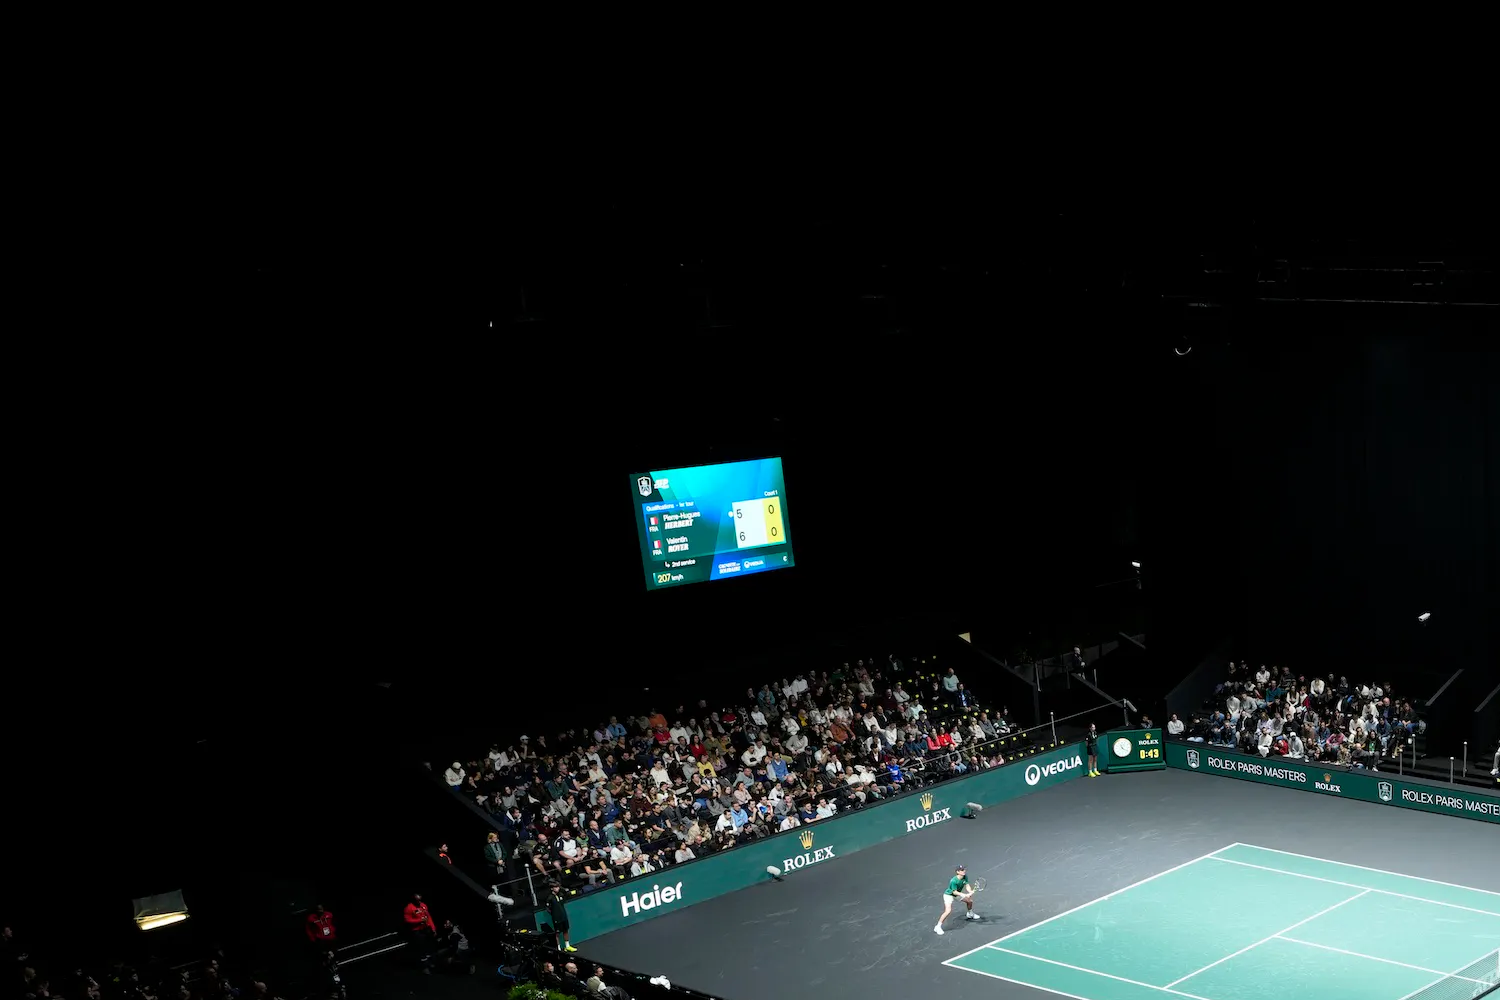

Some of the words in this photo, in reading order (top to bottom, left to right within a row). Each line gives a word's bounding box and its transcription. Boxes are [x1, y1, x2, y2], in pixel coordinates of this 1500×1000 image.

[736, 508, 742, 519] 5
[768, 504, 775, 515] 0
[663, 511, 701, 521] Pierre-Hugues
[665, 519, 694, 529] HERBERT
[740, 531, 746, 541] 6
[771, 526, 777, 537] 0
[666, 536, 688, 545] Valentin
[657, 573, 671, 583] 207
[1139, 748, 1159, 759] 0:43
[1041, 755, 1083, 778] VEOLIA
[1207, 756, 1237, 771] ROLEX
[1237, 762, 1263, 776] PARIS
[1264, 767, 1307, 783] MASTERS
[1315, 781, 1341, 793] ROLEX
[1401, 789, 1434, 805] ROLEX
[1435, 795, 1463, 810] PARIS
[905, 807, 952, 832] ROLEX
[783, 845, 836, 873] ROLEX
[620, 881, 683, 917] Haier
